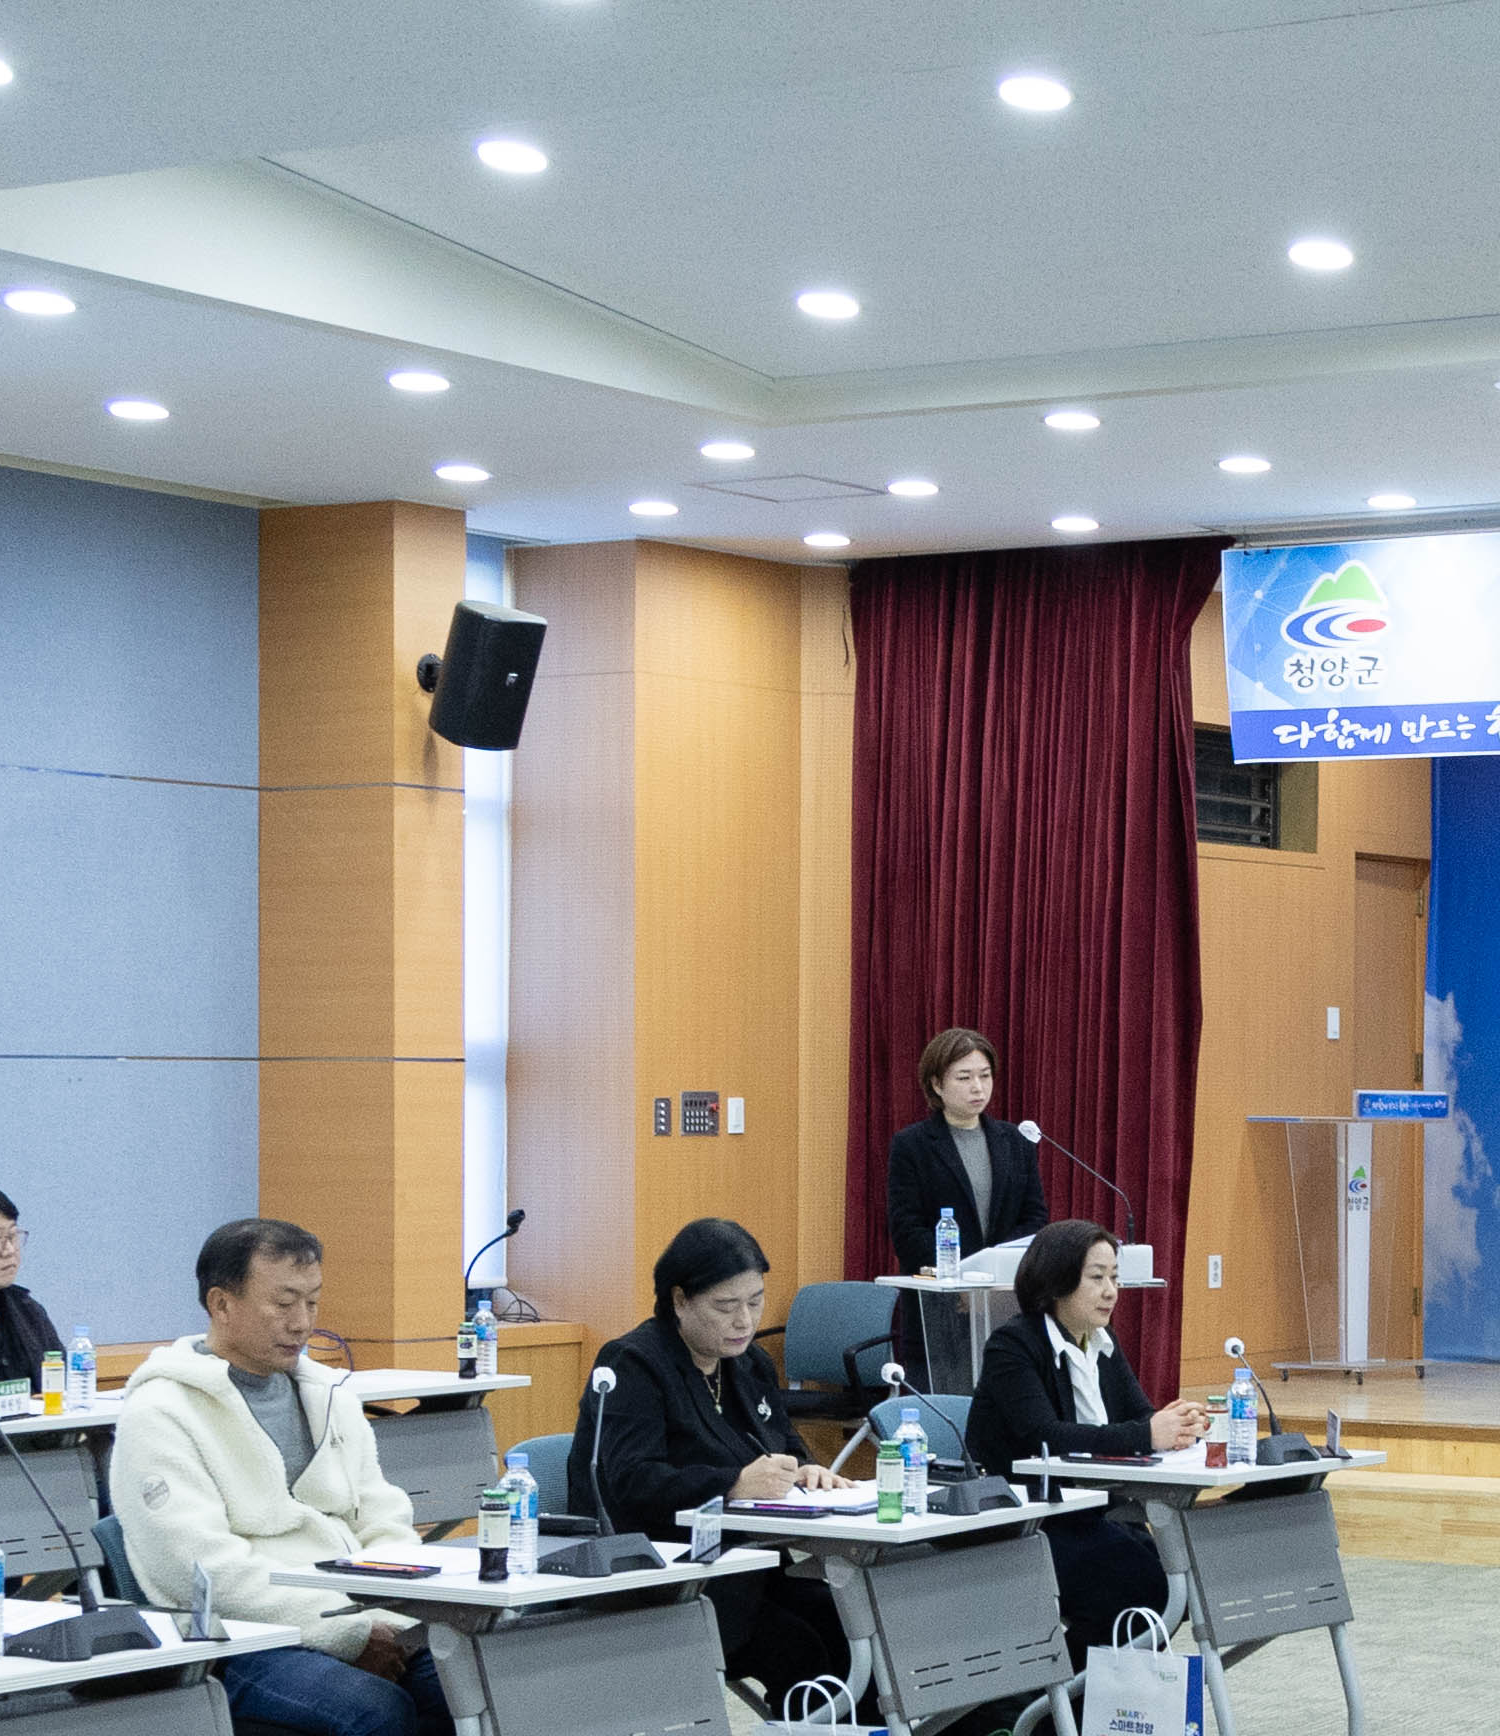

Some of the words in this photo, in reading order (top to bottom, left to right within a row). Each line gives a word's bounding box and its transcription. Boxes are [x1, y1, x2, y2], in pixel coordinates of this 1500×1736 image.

[1287, 654, 1384, 690] 청양군
[1273, 708, 1391, 750] 다함께
[1401, 717, 1476, 742] 만드는
[1108, 1717, 1155, 1736] 스마트청양
